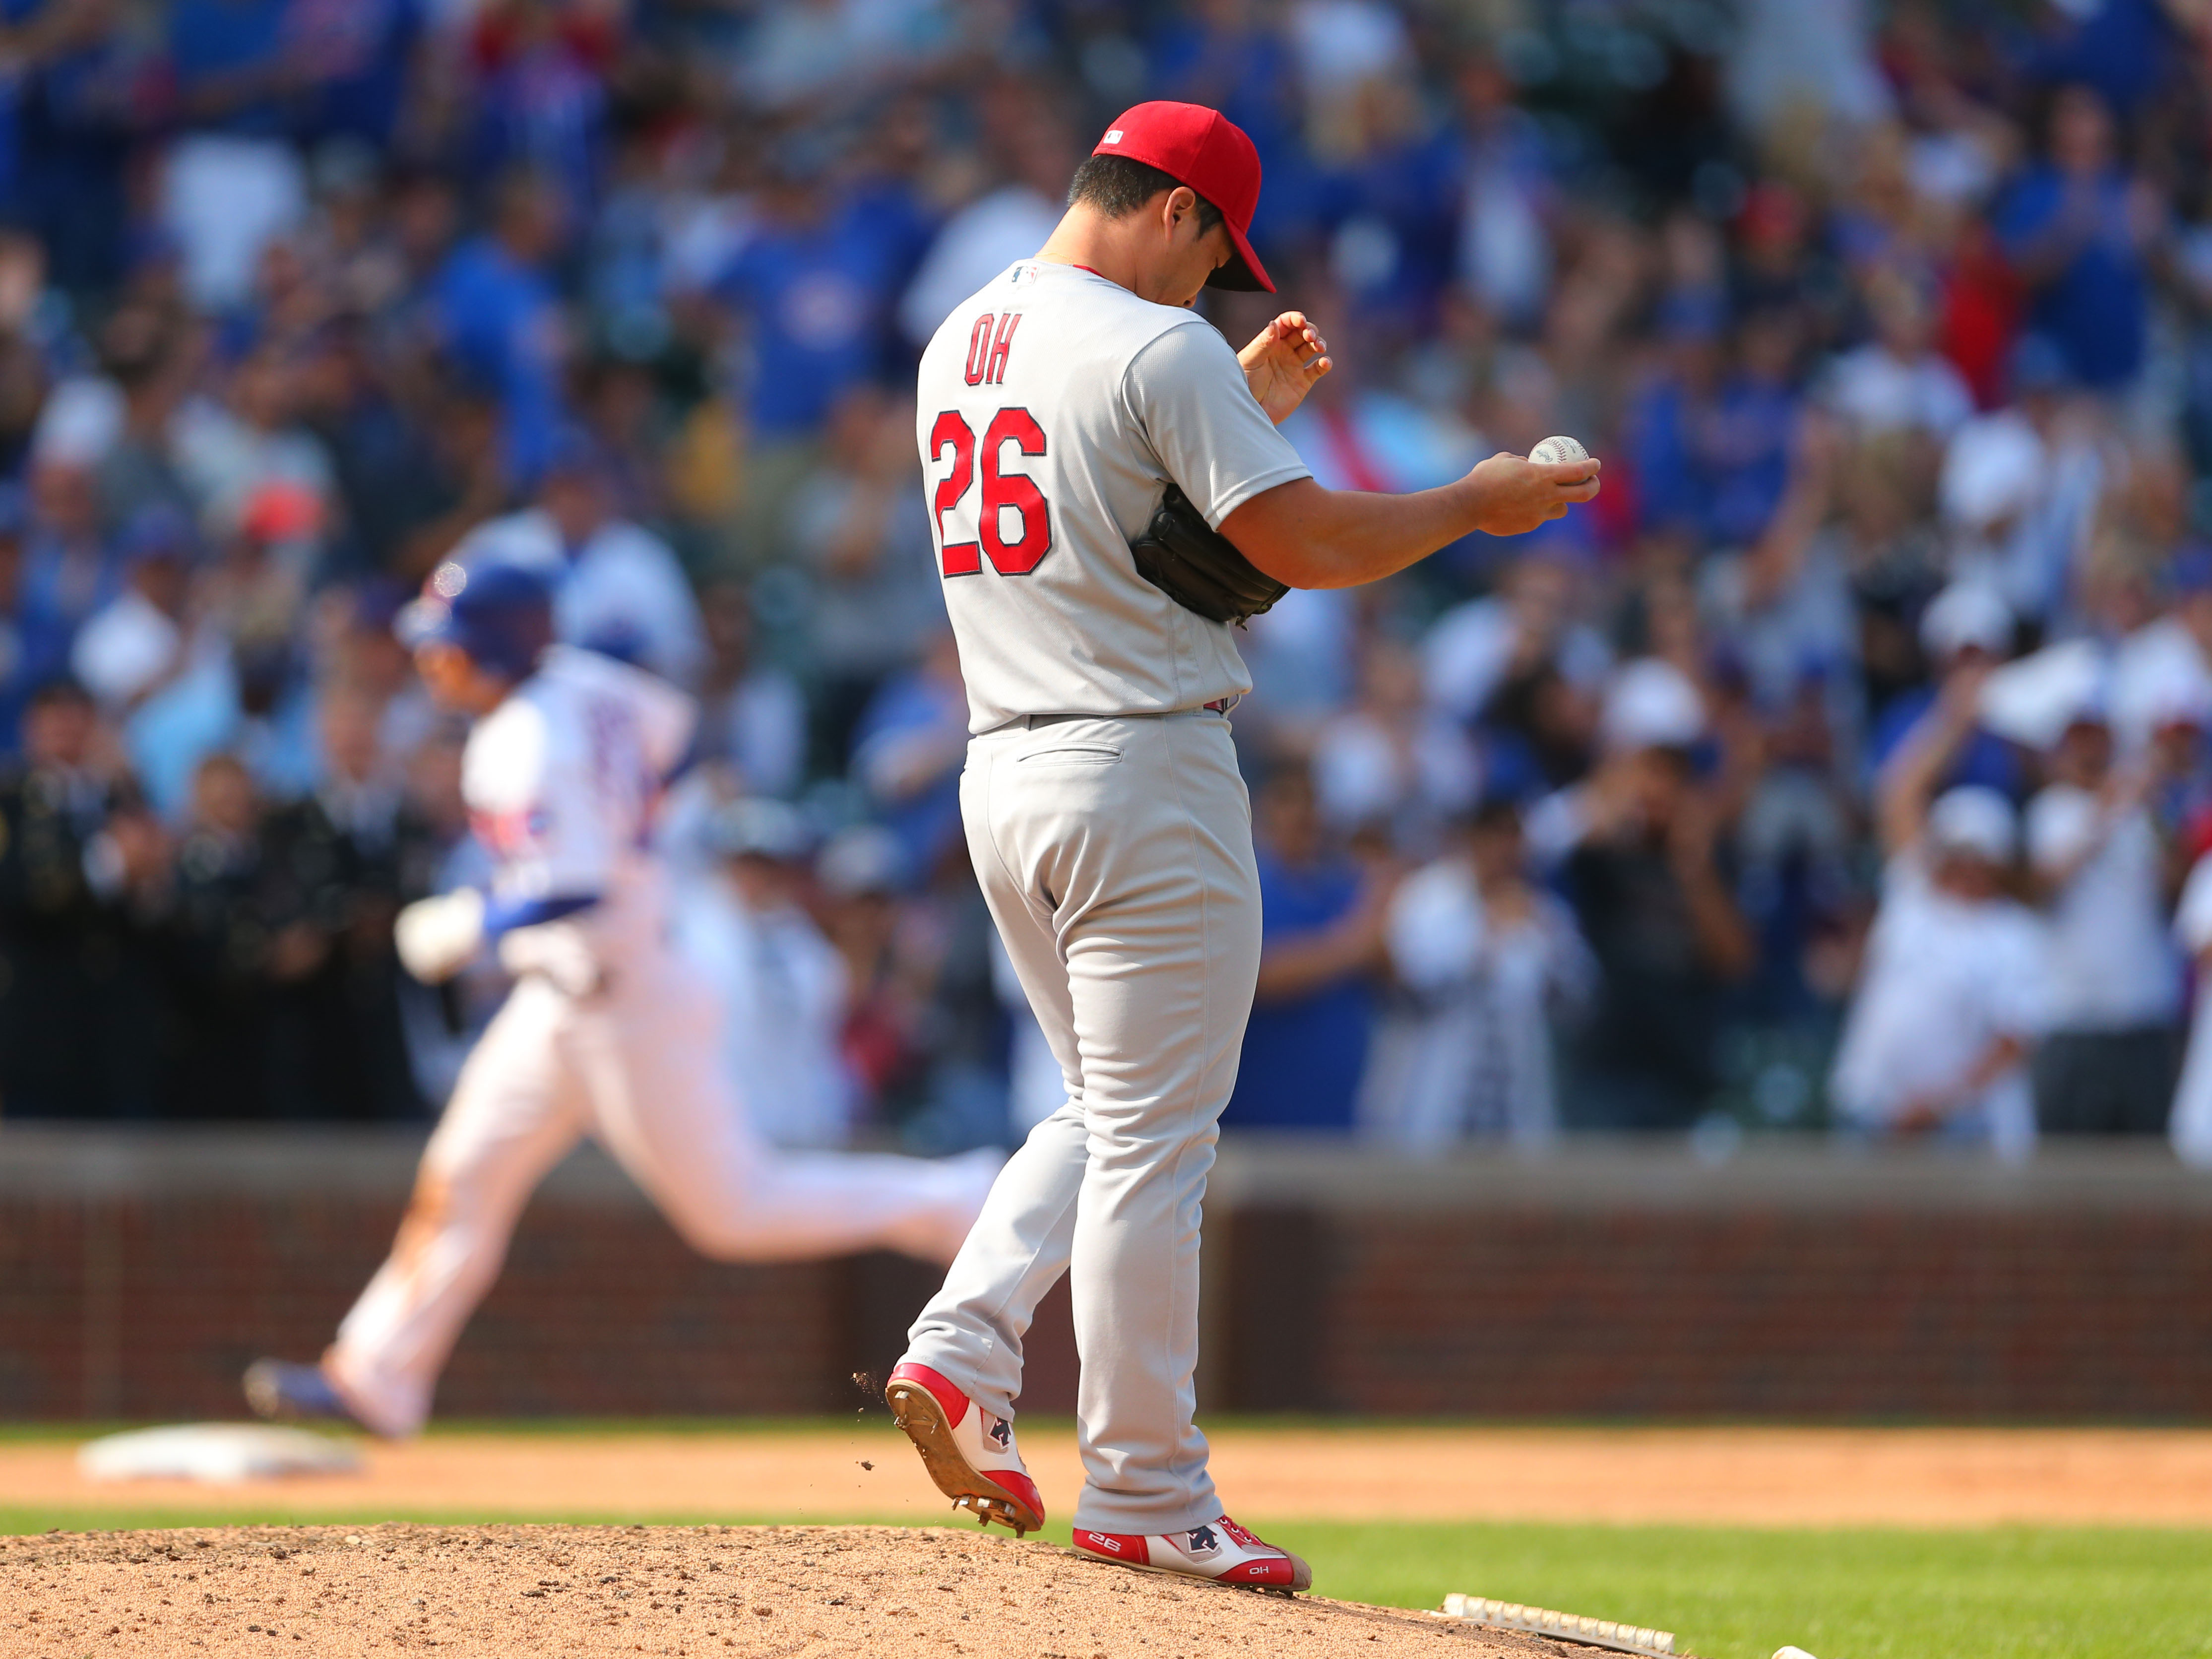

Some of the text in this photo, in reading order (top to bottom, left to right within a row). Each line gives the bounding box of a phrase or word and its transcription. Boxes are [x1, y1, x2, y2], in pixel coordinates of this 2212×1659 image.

[964, 313, 1022, 386] OH
[930, 406, 1052, 579] 26
[1088, 1531, 1122, 1552] 26
[1249, 1565, 1269, 1575] OH
